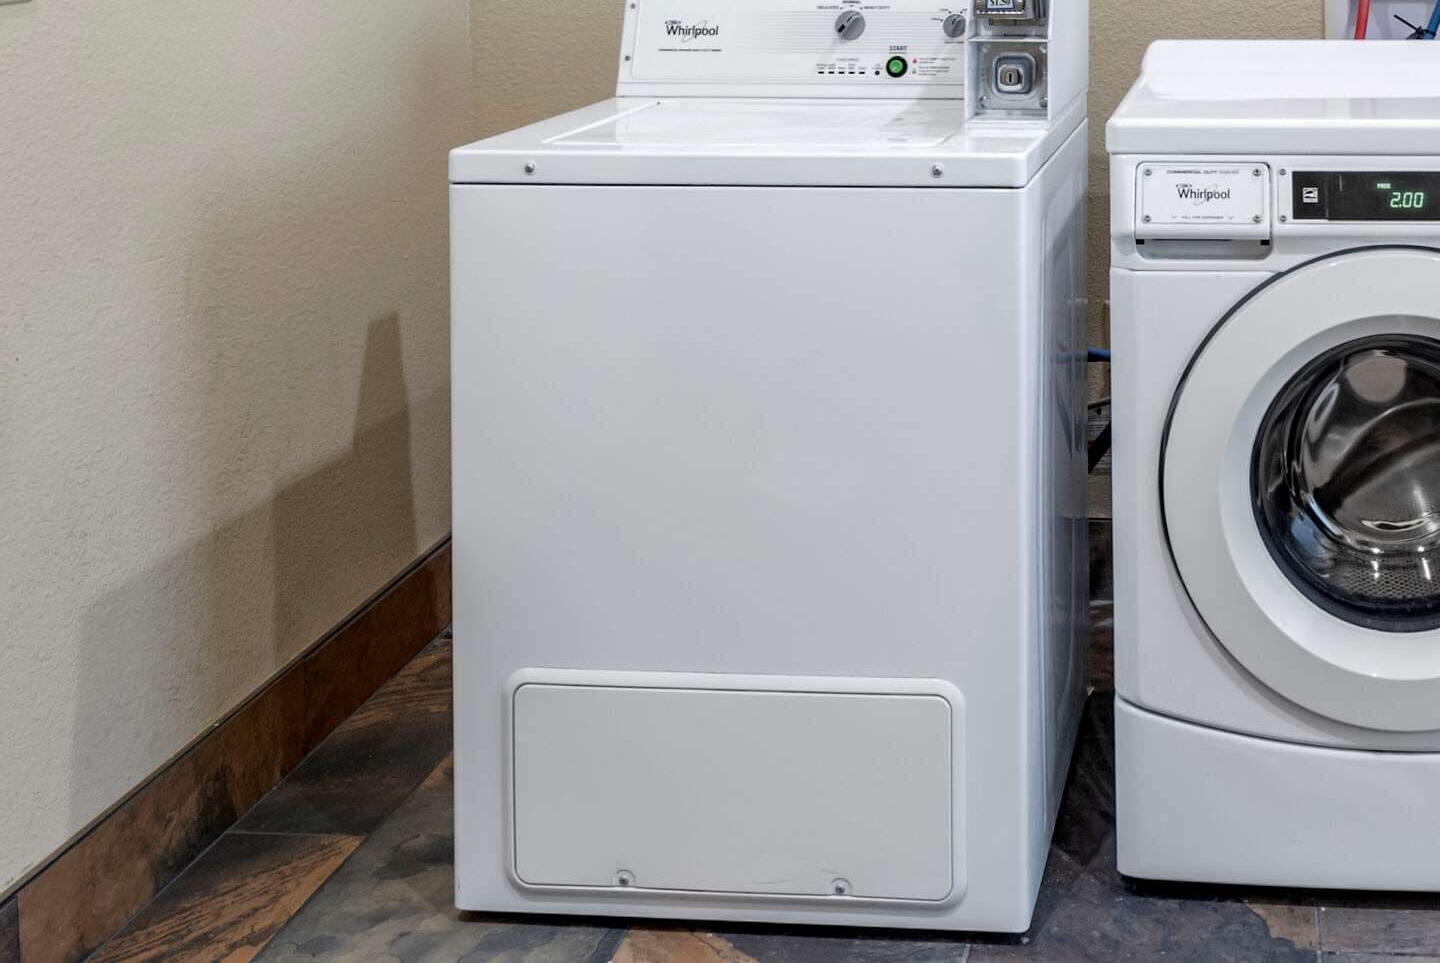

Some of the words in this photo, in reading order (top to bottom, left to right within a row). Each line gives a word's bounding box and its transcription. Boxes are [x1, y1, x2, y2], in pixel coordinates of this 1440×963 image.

[666, 24, 719, 39] Whirlpool
[1177, 188, 1231, 202] Whirlpool
[1390, 191, 1424, 208] 2.00
